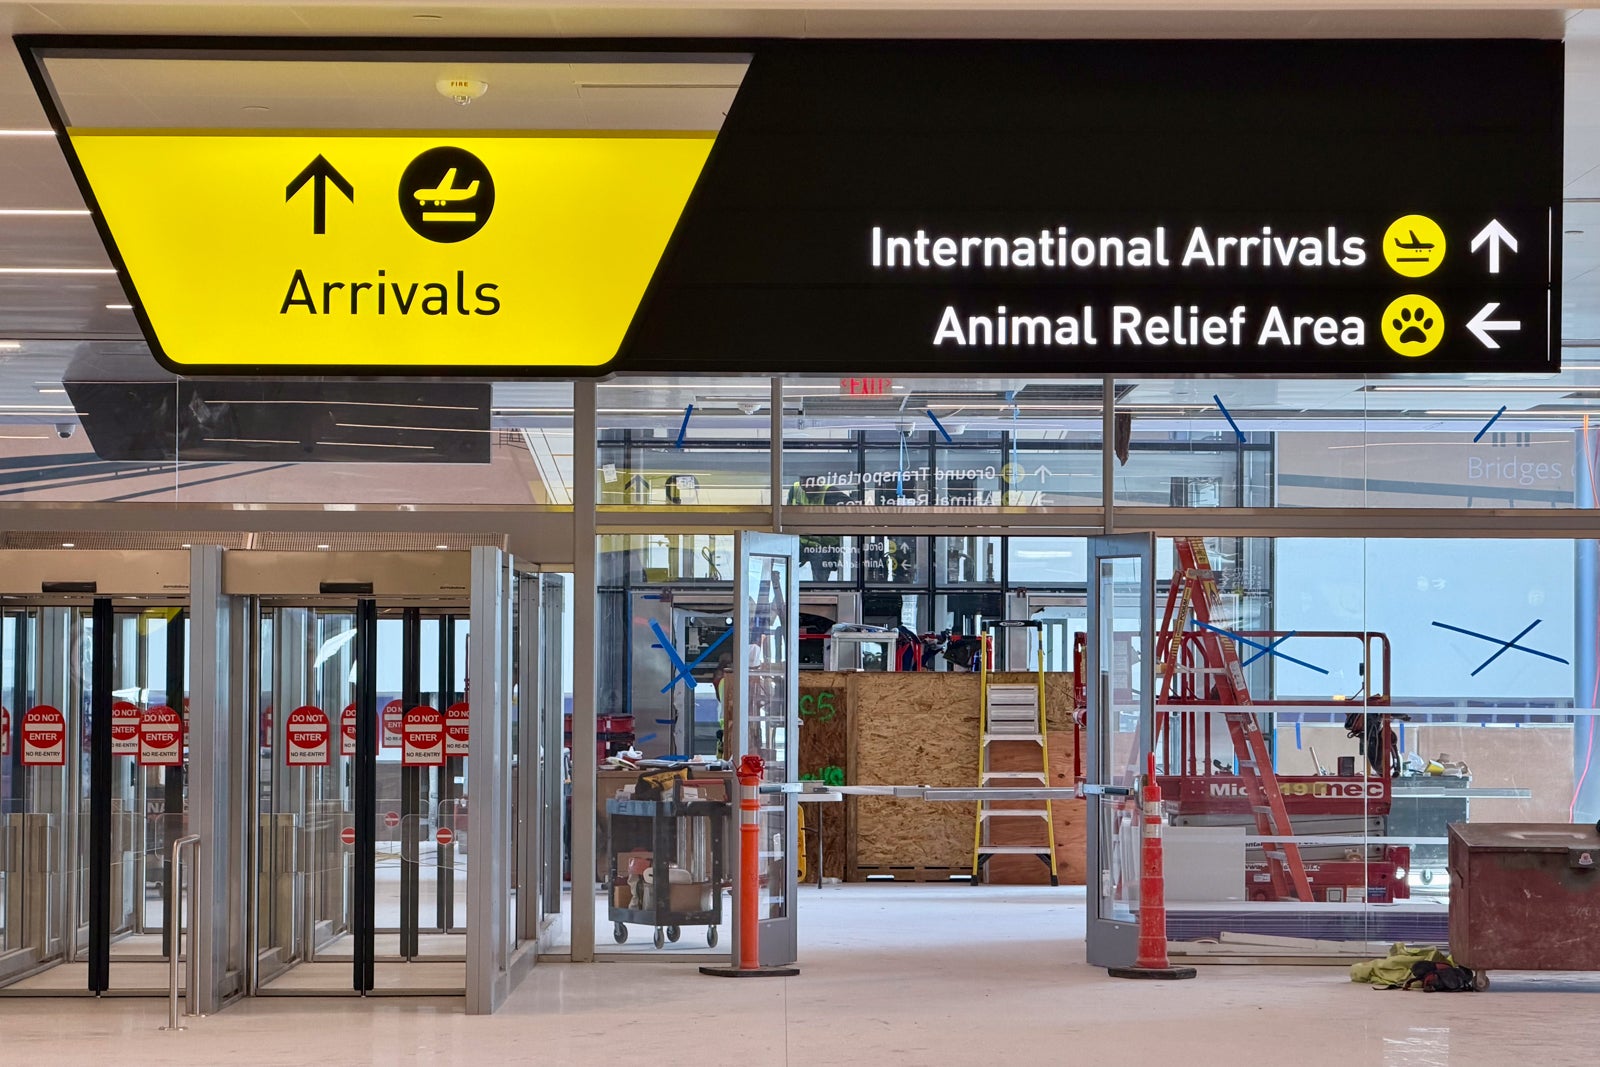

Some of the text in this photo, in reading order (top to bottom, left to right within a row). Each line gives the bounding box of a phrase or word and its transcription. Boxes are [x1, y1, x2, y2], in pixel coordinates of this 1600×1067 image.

[872, 226, 1367, 267] International Arrivals
[281, 270, 501, 315] Arrivals
[933, 306, 1366, 346] Animal Relief Area
[1468, 456, 1562, 485] Bridges
[27, 714, 60, 722] DO NOT
[144, 714, 176, 722] DO NOT
[292, 714, 324, 722] DO NOT
[112, 726, 135, 734] ENTER
[146, 733, 174, 741] ENTER
[294, 733, 322, 741] ENTER
[409, 733, 437, 741] ENTER
